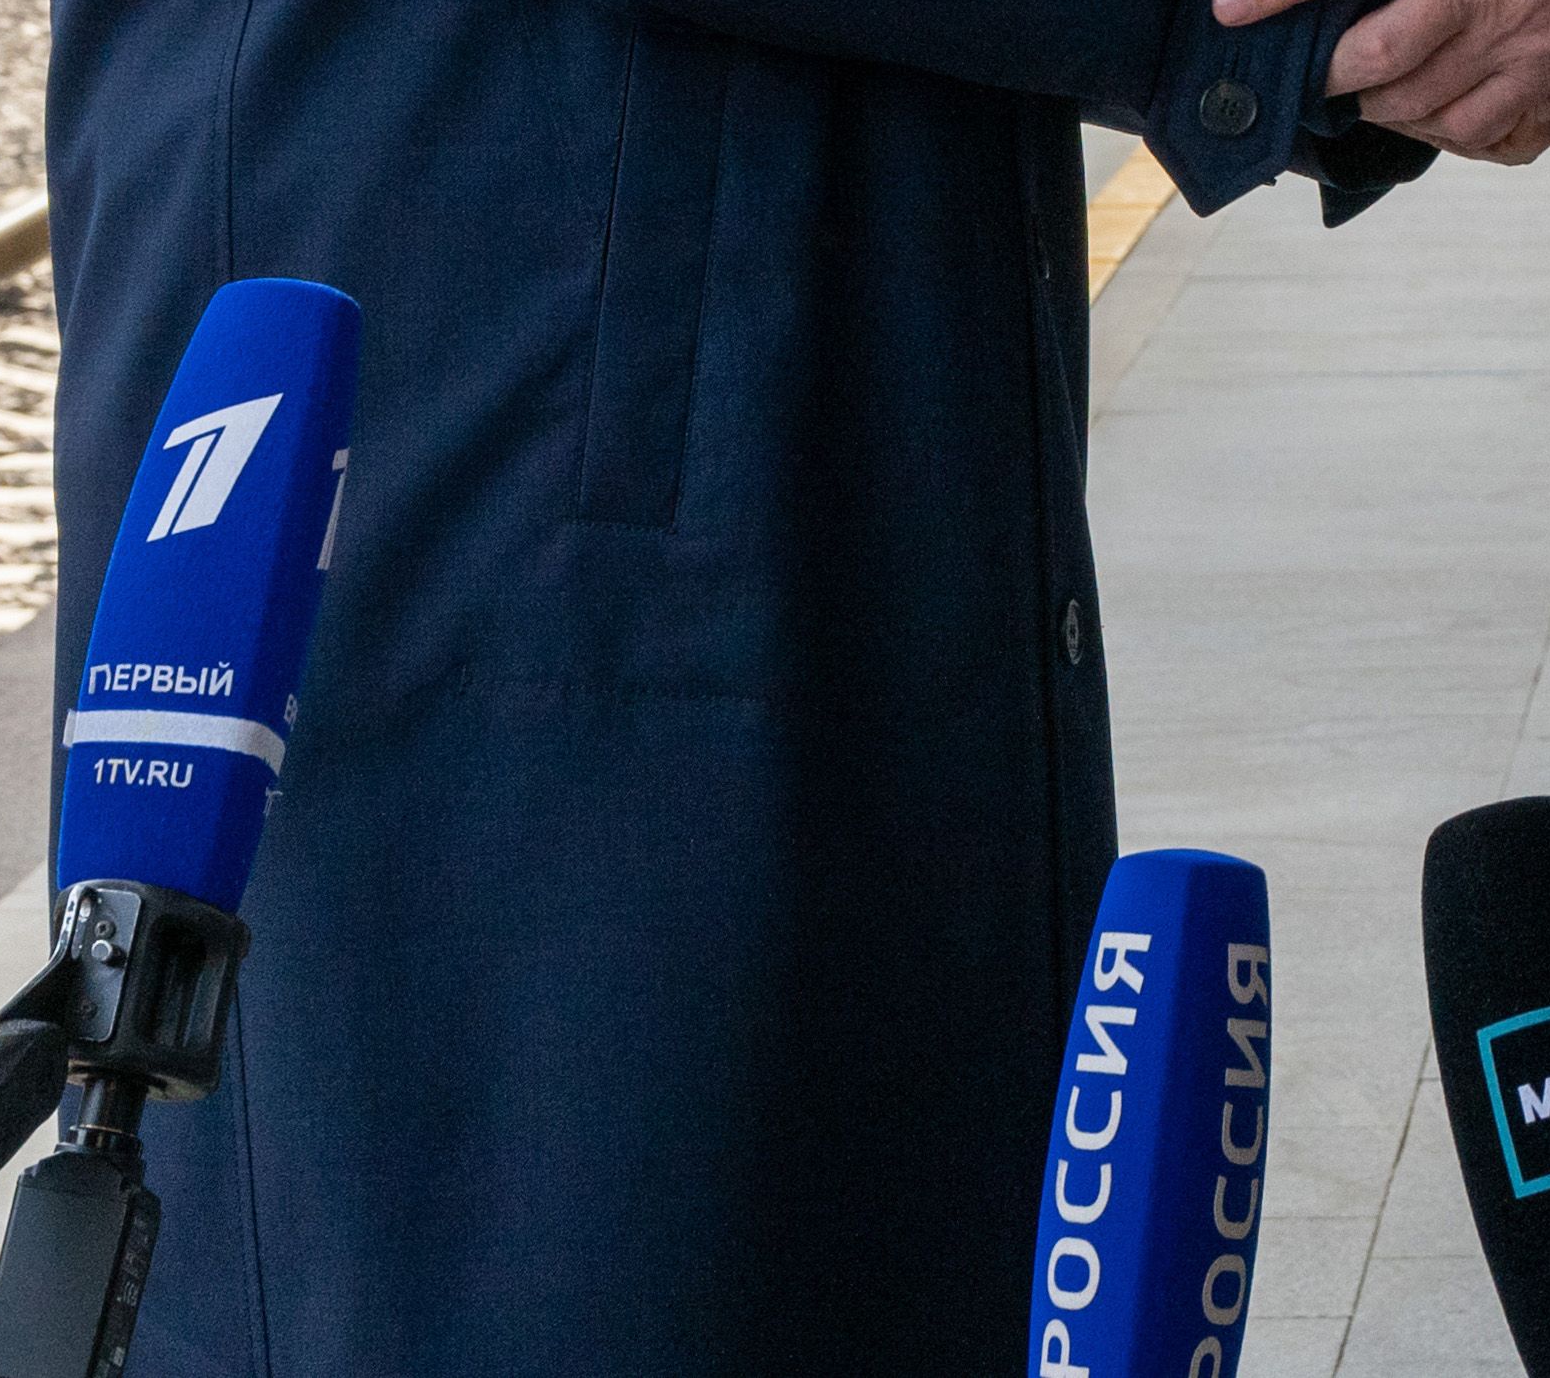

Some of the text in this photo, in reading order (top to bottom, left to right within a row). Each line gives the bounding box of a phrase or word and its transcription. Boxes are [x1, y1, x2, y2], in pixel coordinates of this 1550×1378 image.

[88, 662, 234, 696] ПЕРВЫЙ
[93, 758, 194, 788] 1TV.RU
[1038, 931, 1153, 1378] РОССИЯ
